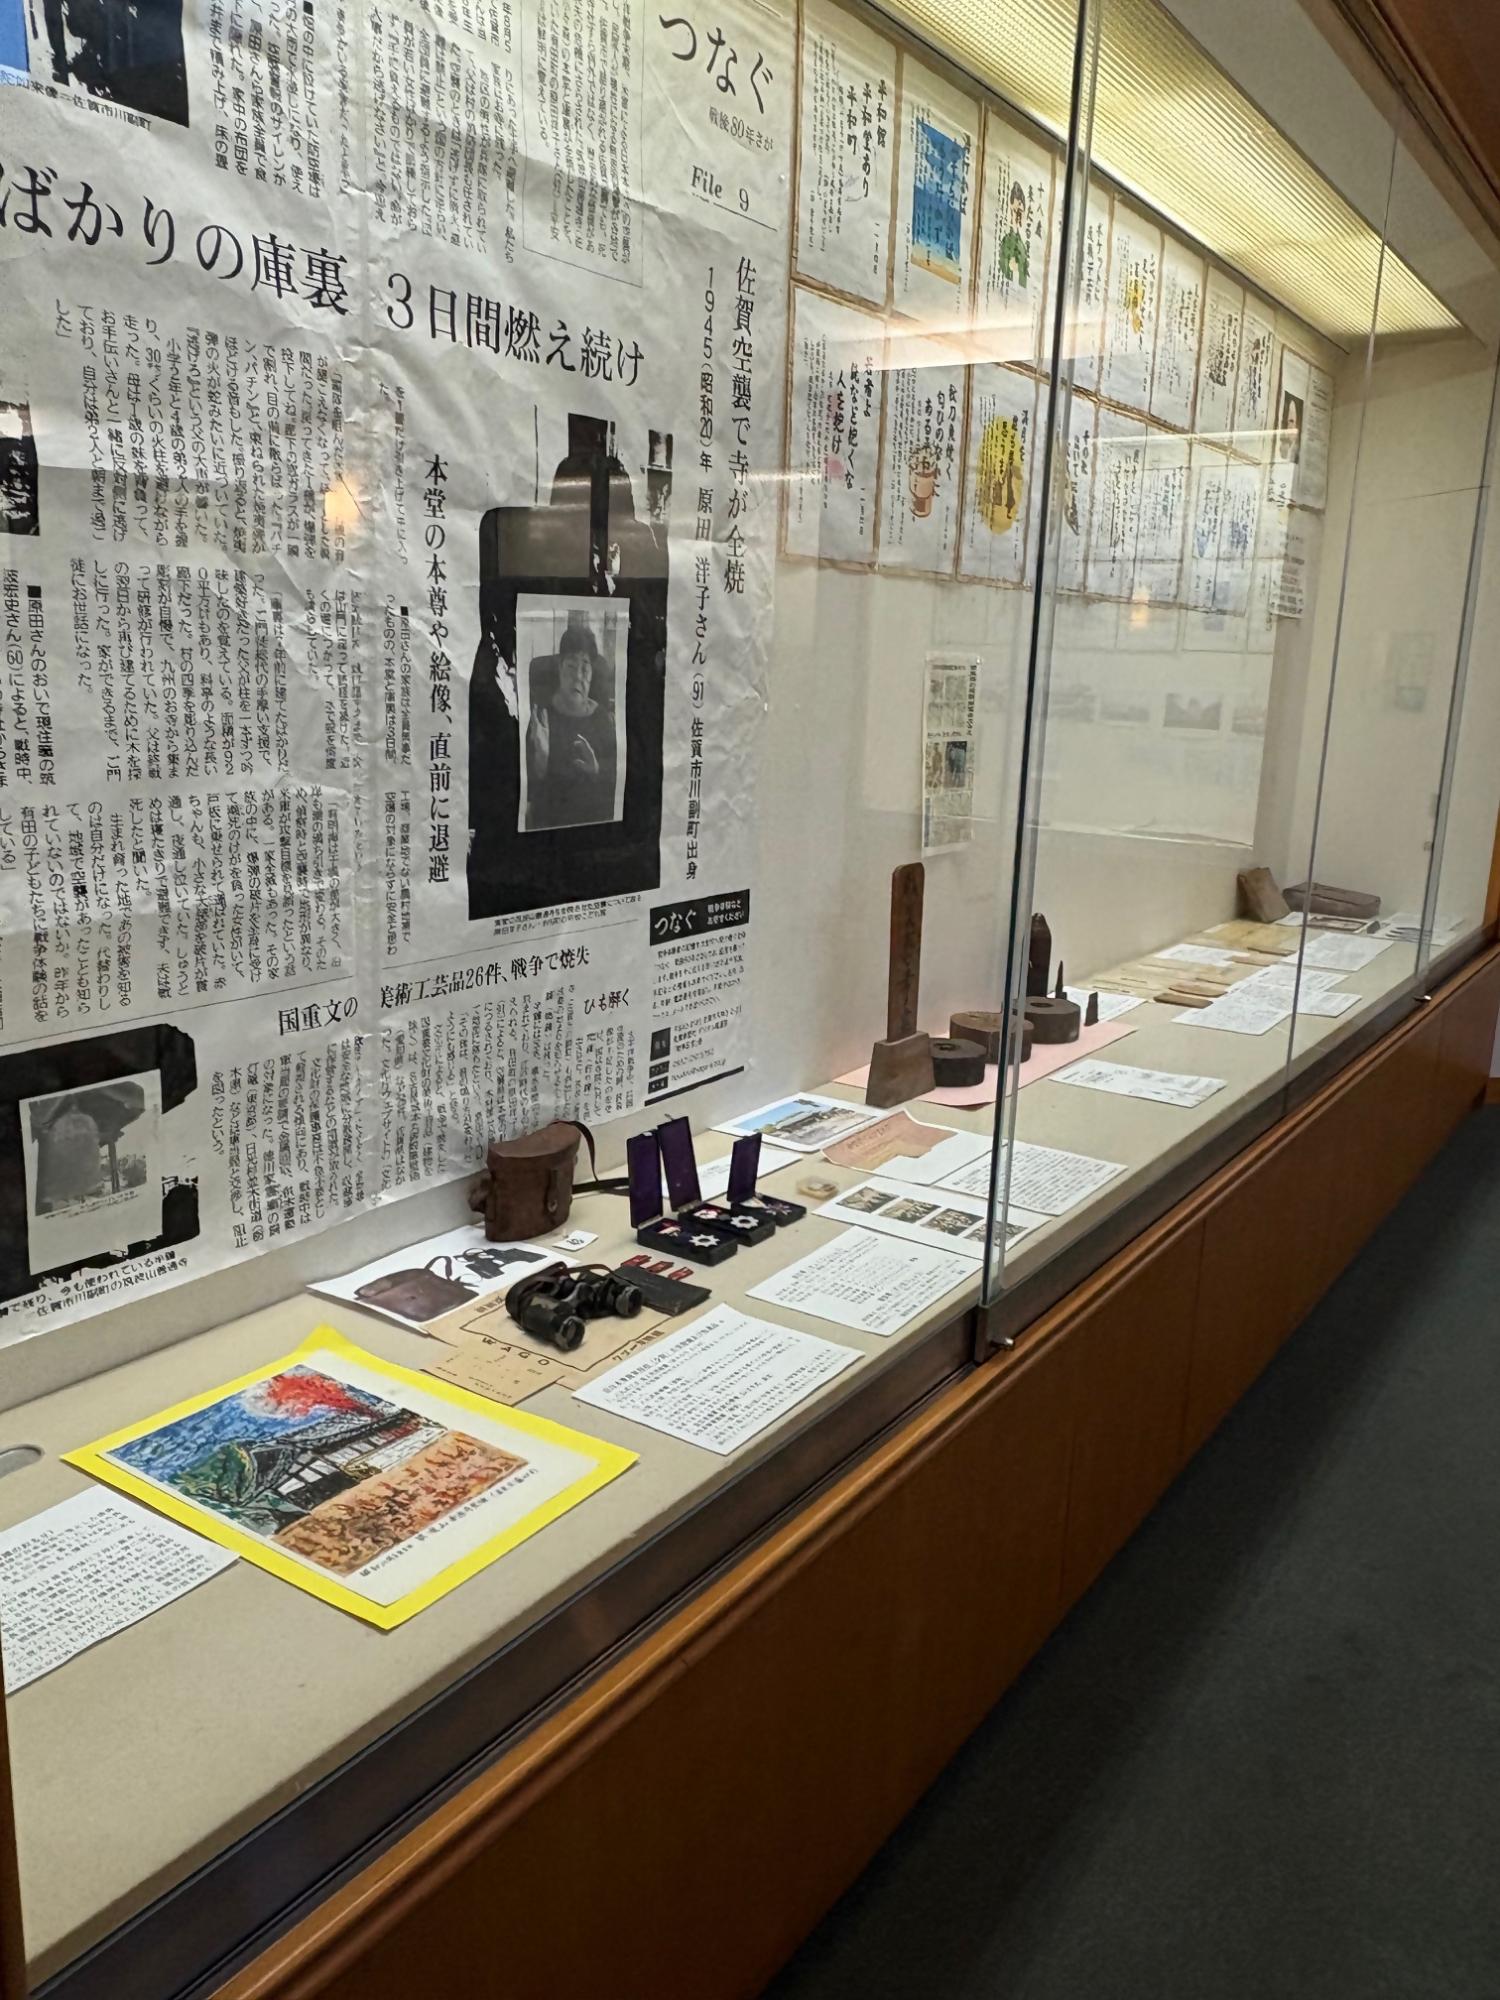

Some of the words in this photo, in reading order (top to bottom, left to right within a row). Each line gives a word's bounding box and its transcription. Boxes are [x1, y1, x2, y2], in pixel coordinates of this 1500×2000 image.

[658, 14, 773, 114] つなぐ
[691, 164, 724, 200] File
[738, 188, 750, 213] 9
[387, 272, 646, 387] 3日間燃え続け
[724, 255, 758, 595] 佐賀空襲で寺が全焼
[423, 453, 453, 885] 本堂の本尊や絵像、直前に退避
[653, 909, 697, 937] つなぐ
[278, 996, 359, 1036] 国重文の
